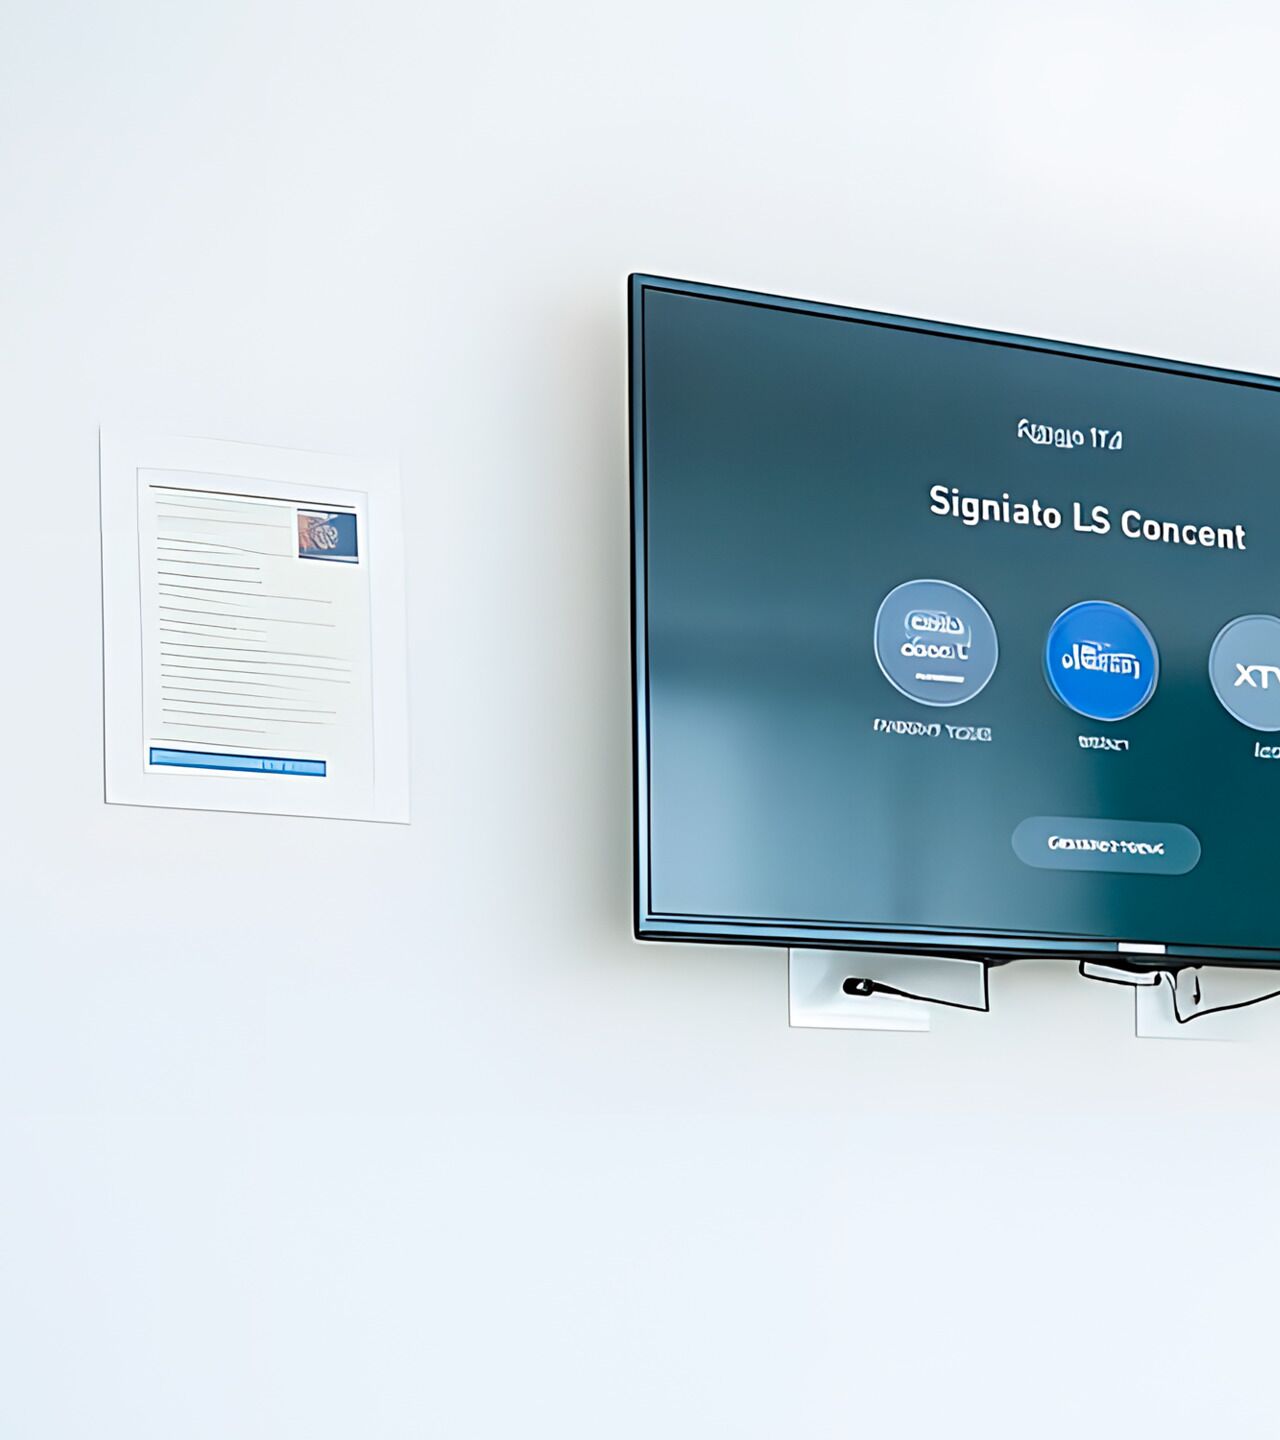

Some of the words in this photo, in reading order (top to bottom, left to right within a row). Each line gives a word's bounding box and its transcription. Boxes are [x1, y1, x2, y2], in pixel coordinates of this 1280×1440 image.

[928, 484, 1063, 530] Signiato
[1073, 501, 1112, 536] LS
[1121, 509, 1248, 552] Concent
